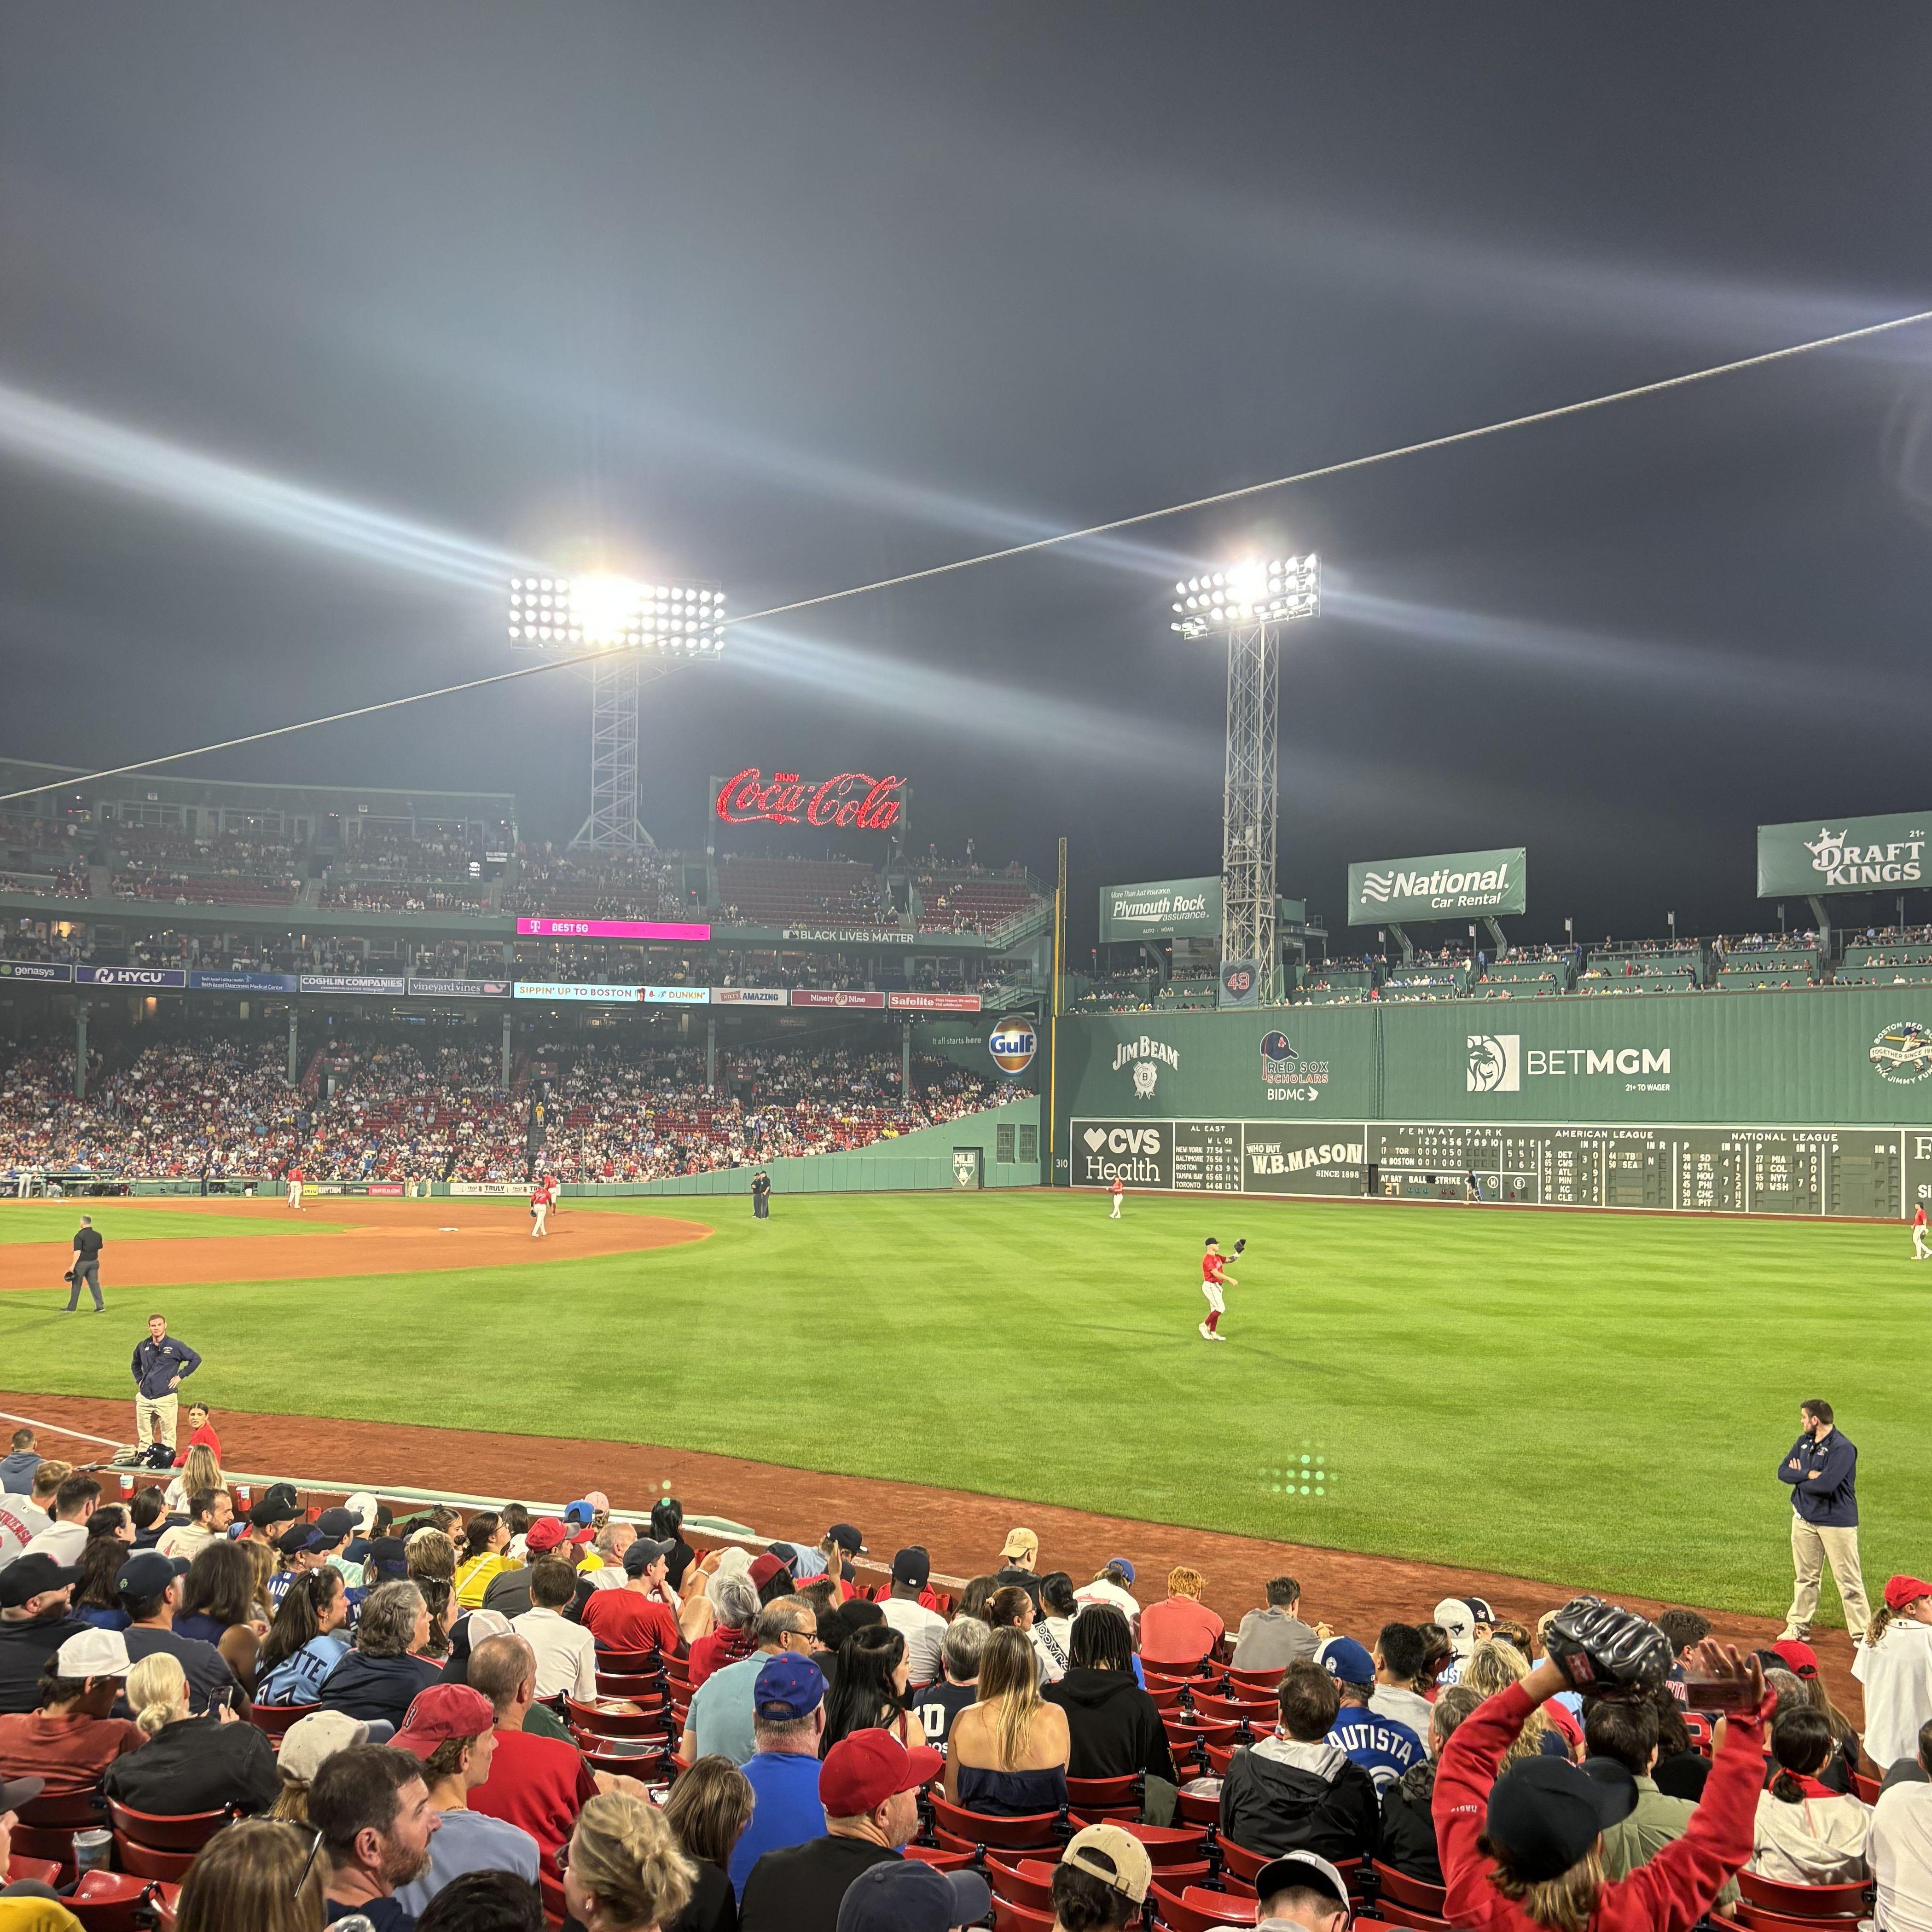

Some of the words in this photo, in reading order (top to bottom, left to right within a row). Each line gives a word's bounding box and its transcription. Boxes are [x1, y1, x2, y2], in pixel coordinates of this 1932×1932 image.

[716, 768, 906, 829] Coca-Cola
[1812, 841, 1925, 871] DRAFT
[1826, 862, 1921, 885] KINGS
[1114, 898, 1169, 917] Plymouth
[1173, 894, 1205, 912] Rock
[1431, 897, 1453, 908] Car
[1458, 893, 1501, 907] Rental
[552, 923, 574, 932] BEST
[576, 924, 588, 933] 5G
[801, 931, 836, 941] BLACK
[839, 931, 869, 941] LIVES
[872, 933, 913, 943] MATTER
[15, 967, 54, 977] genasys
[118, 972, 162, 982] HYCU
[1227, 972, 1250, 990] 49
[413, 982, 454, 992] vineyard
[456, 982, 481, 992] vines
[591, 989, 631, 997] BOSTON
[891, 997, 934, 1006] Safelite
[1874, 1022, 1902, 1044] BOSTON
[1906, 1022, 1922, 1030] RED
[990, 1035, 1033, 1053] Gulf
[1872, 1049, 1902, 1058] TOGETHER
[1904, 1050, 1922, 1059] SINCE
[1527, 1048, 1670, 1075] BETMGM
[1268, 1062, 1295, 1073] RED
[1300, 1061, 1329, 1073] SOX
[1267, 1074, 1328, 1083] SCHOLARS
[1888, 1076, 1915, 1084] JIMMY
[1267, 1088, 1305, 1101] BIDMC
[1108, 1128, 1160, 1154] CVS
[1793, 1133, 1838, 1142] LEAGUE
[1491, 1139, 1498, 1147] 10
[1247, 1145, 1264, 1153] WHO
[1266, 1145, 1280, 1153] BUT
[954, 1154, 974, 1164] MLB
[1056, 1159, 1068, 1168] 310
[1086, 1156, 1160, 1182] Health
[1435, 1176, 1460, 1185] STRIKE
[1386, 1183, 1399, 1195] 27
[1697, 1190, 1713, 1198] CHC
